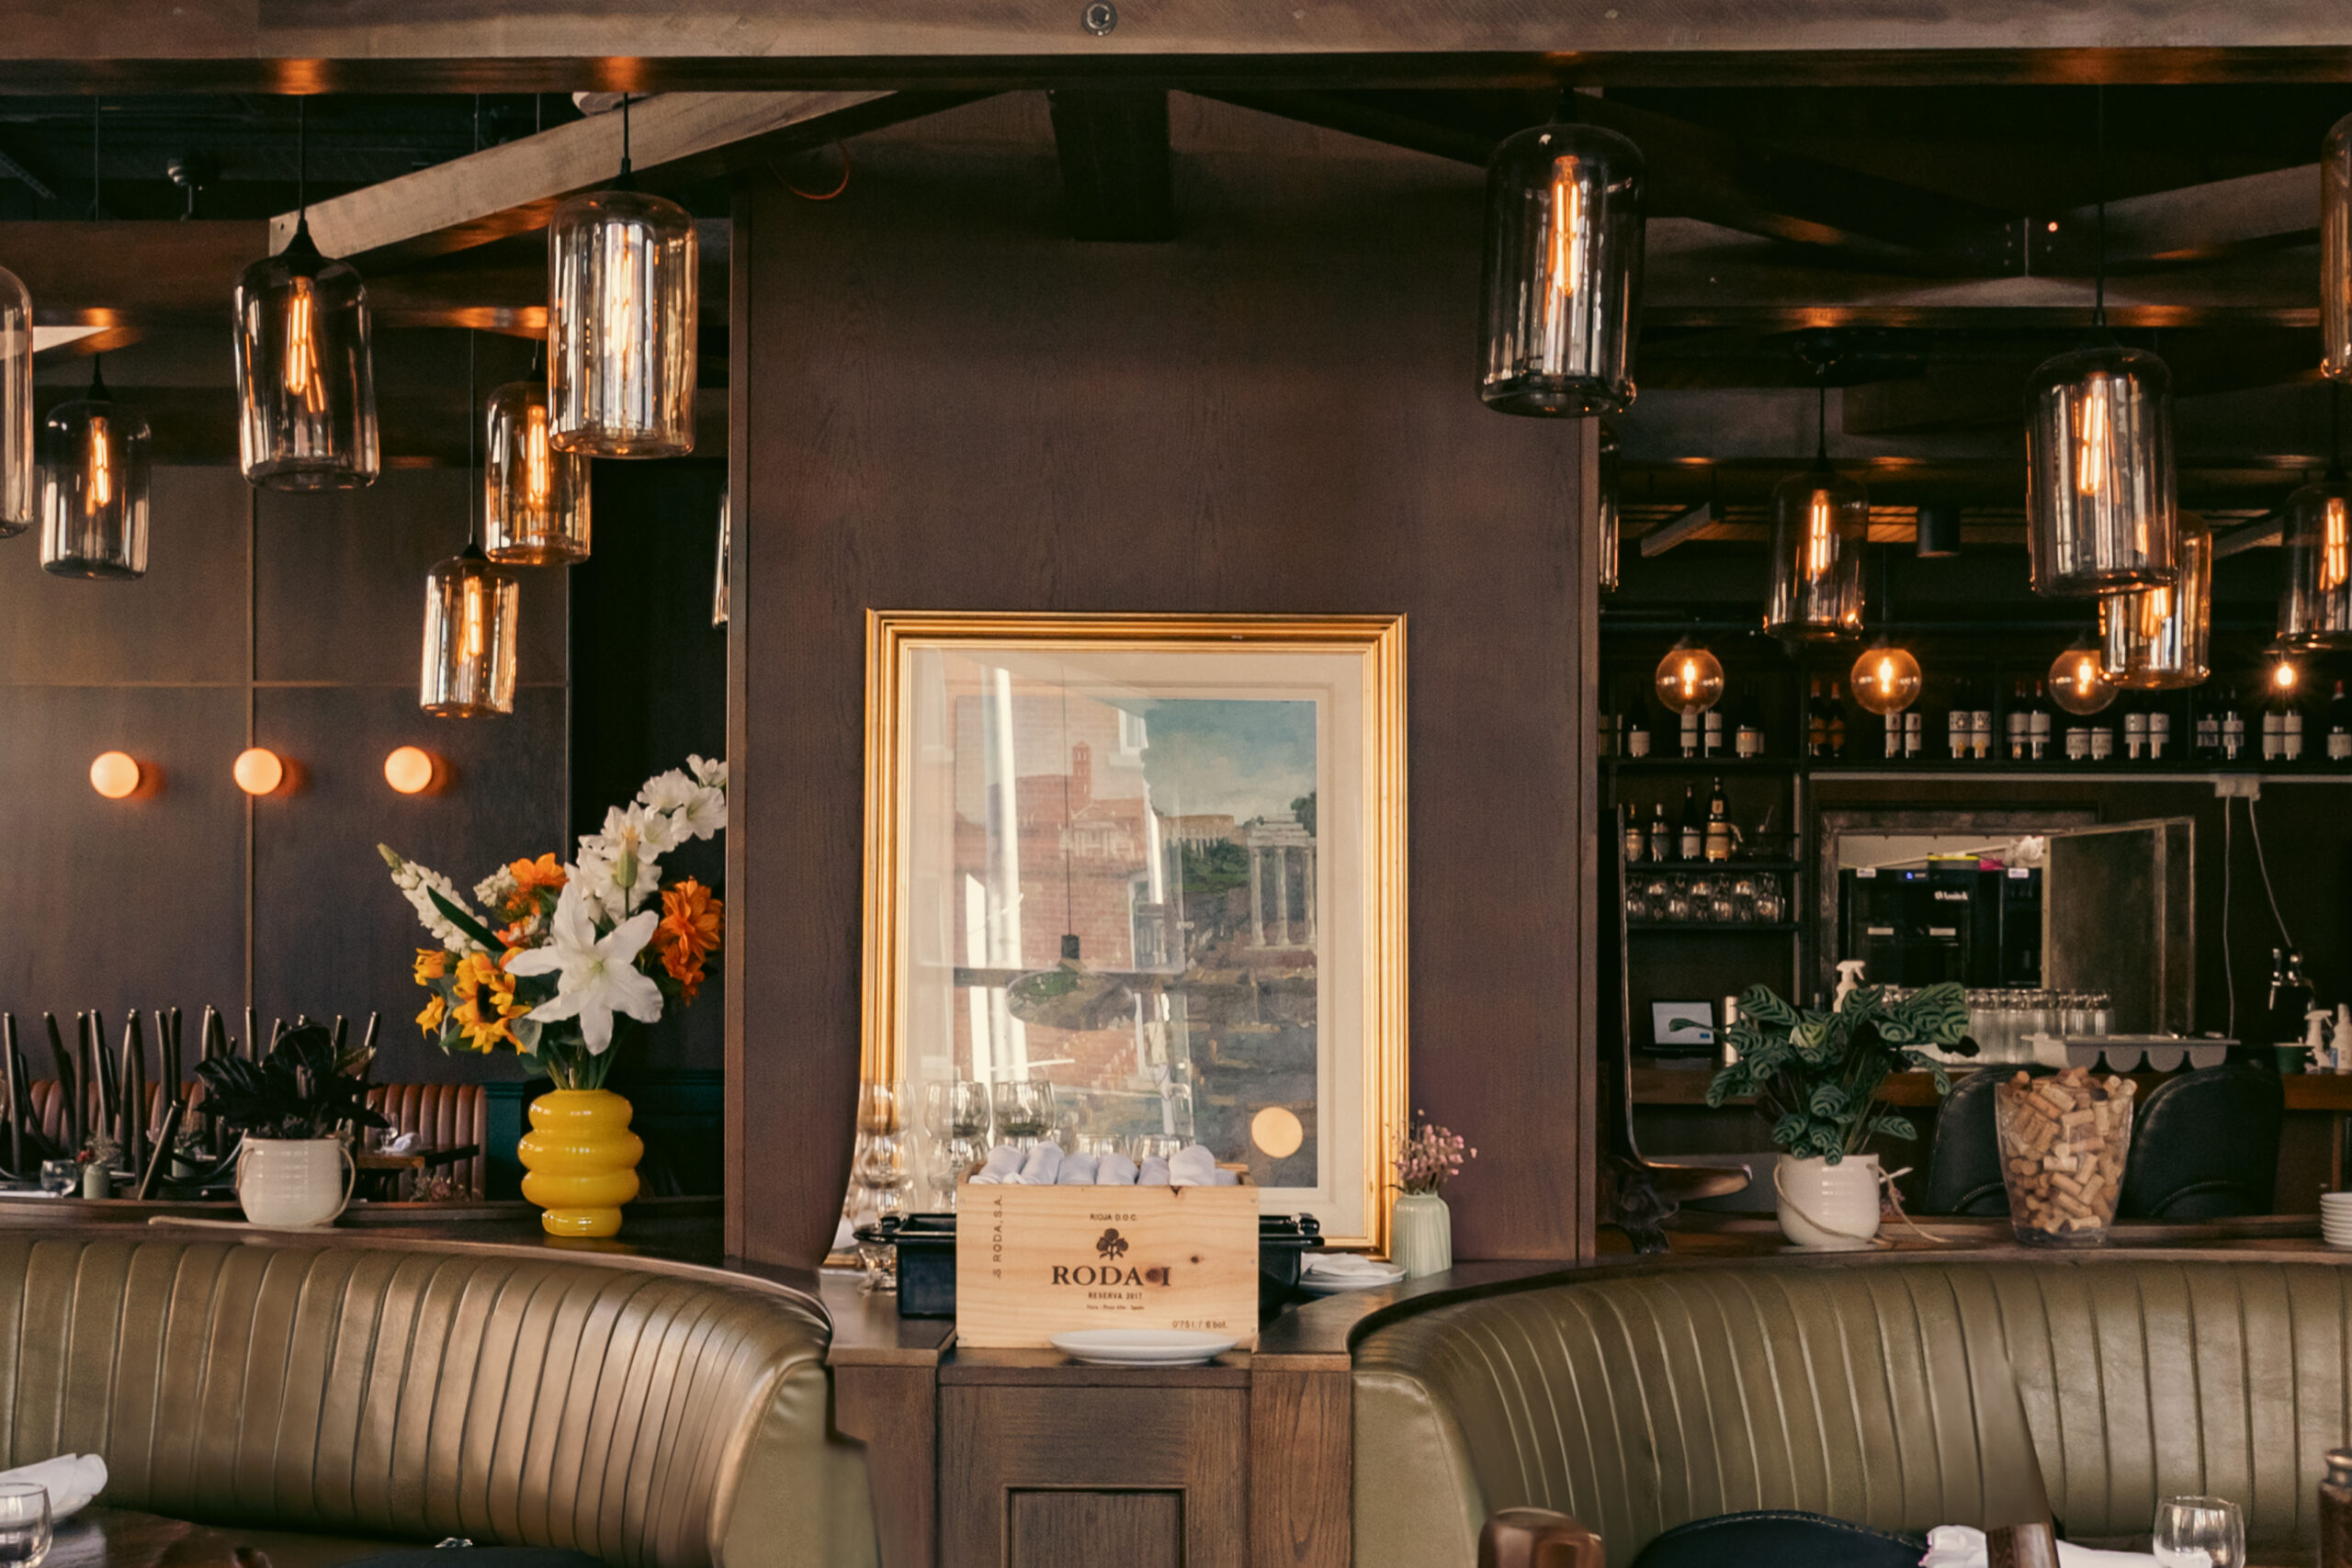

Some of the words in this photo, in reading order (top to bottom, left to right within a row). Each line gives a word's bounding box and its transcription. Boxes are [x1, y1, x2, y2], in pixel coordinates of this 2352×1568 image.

[1090, 1213, 1112, 1221] RIOJA
[1051, 1265, 1144, 1286] RODA
[1160, 1267, 1171, 1286] I
[1088, 1291, 1123, 1300] RESERVA
